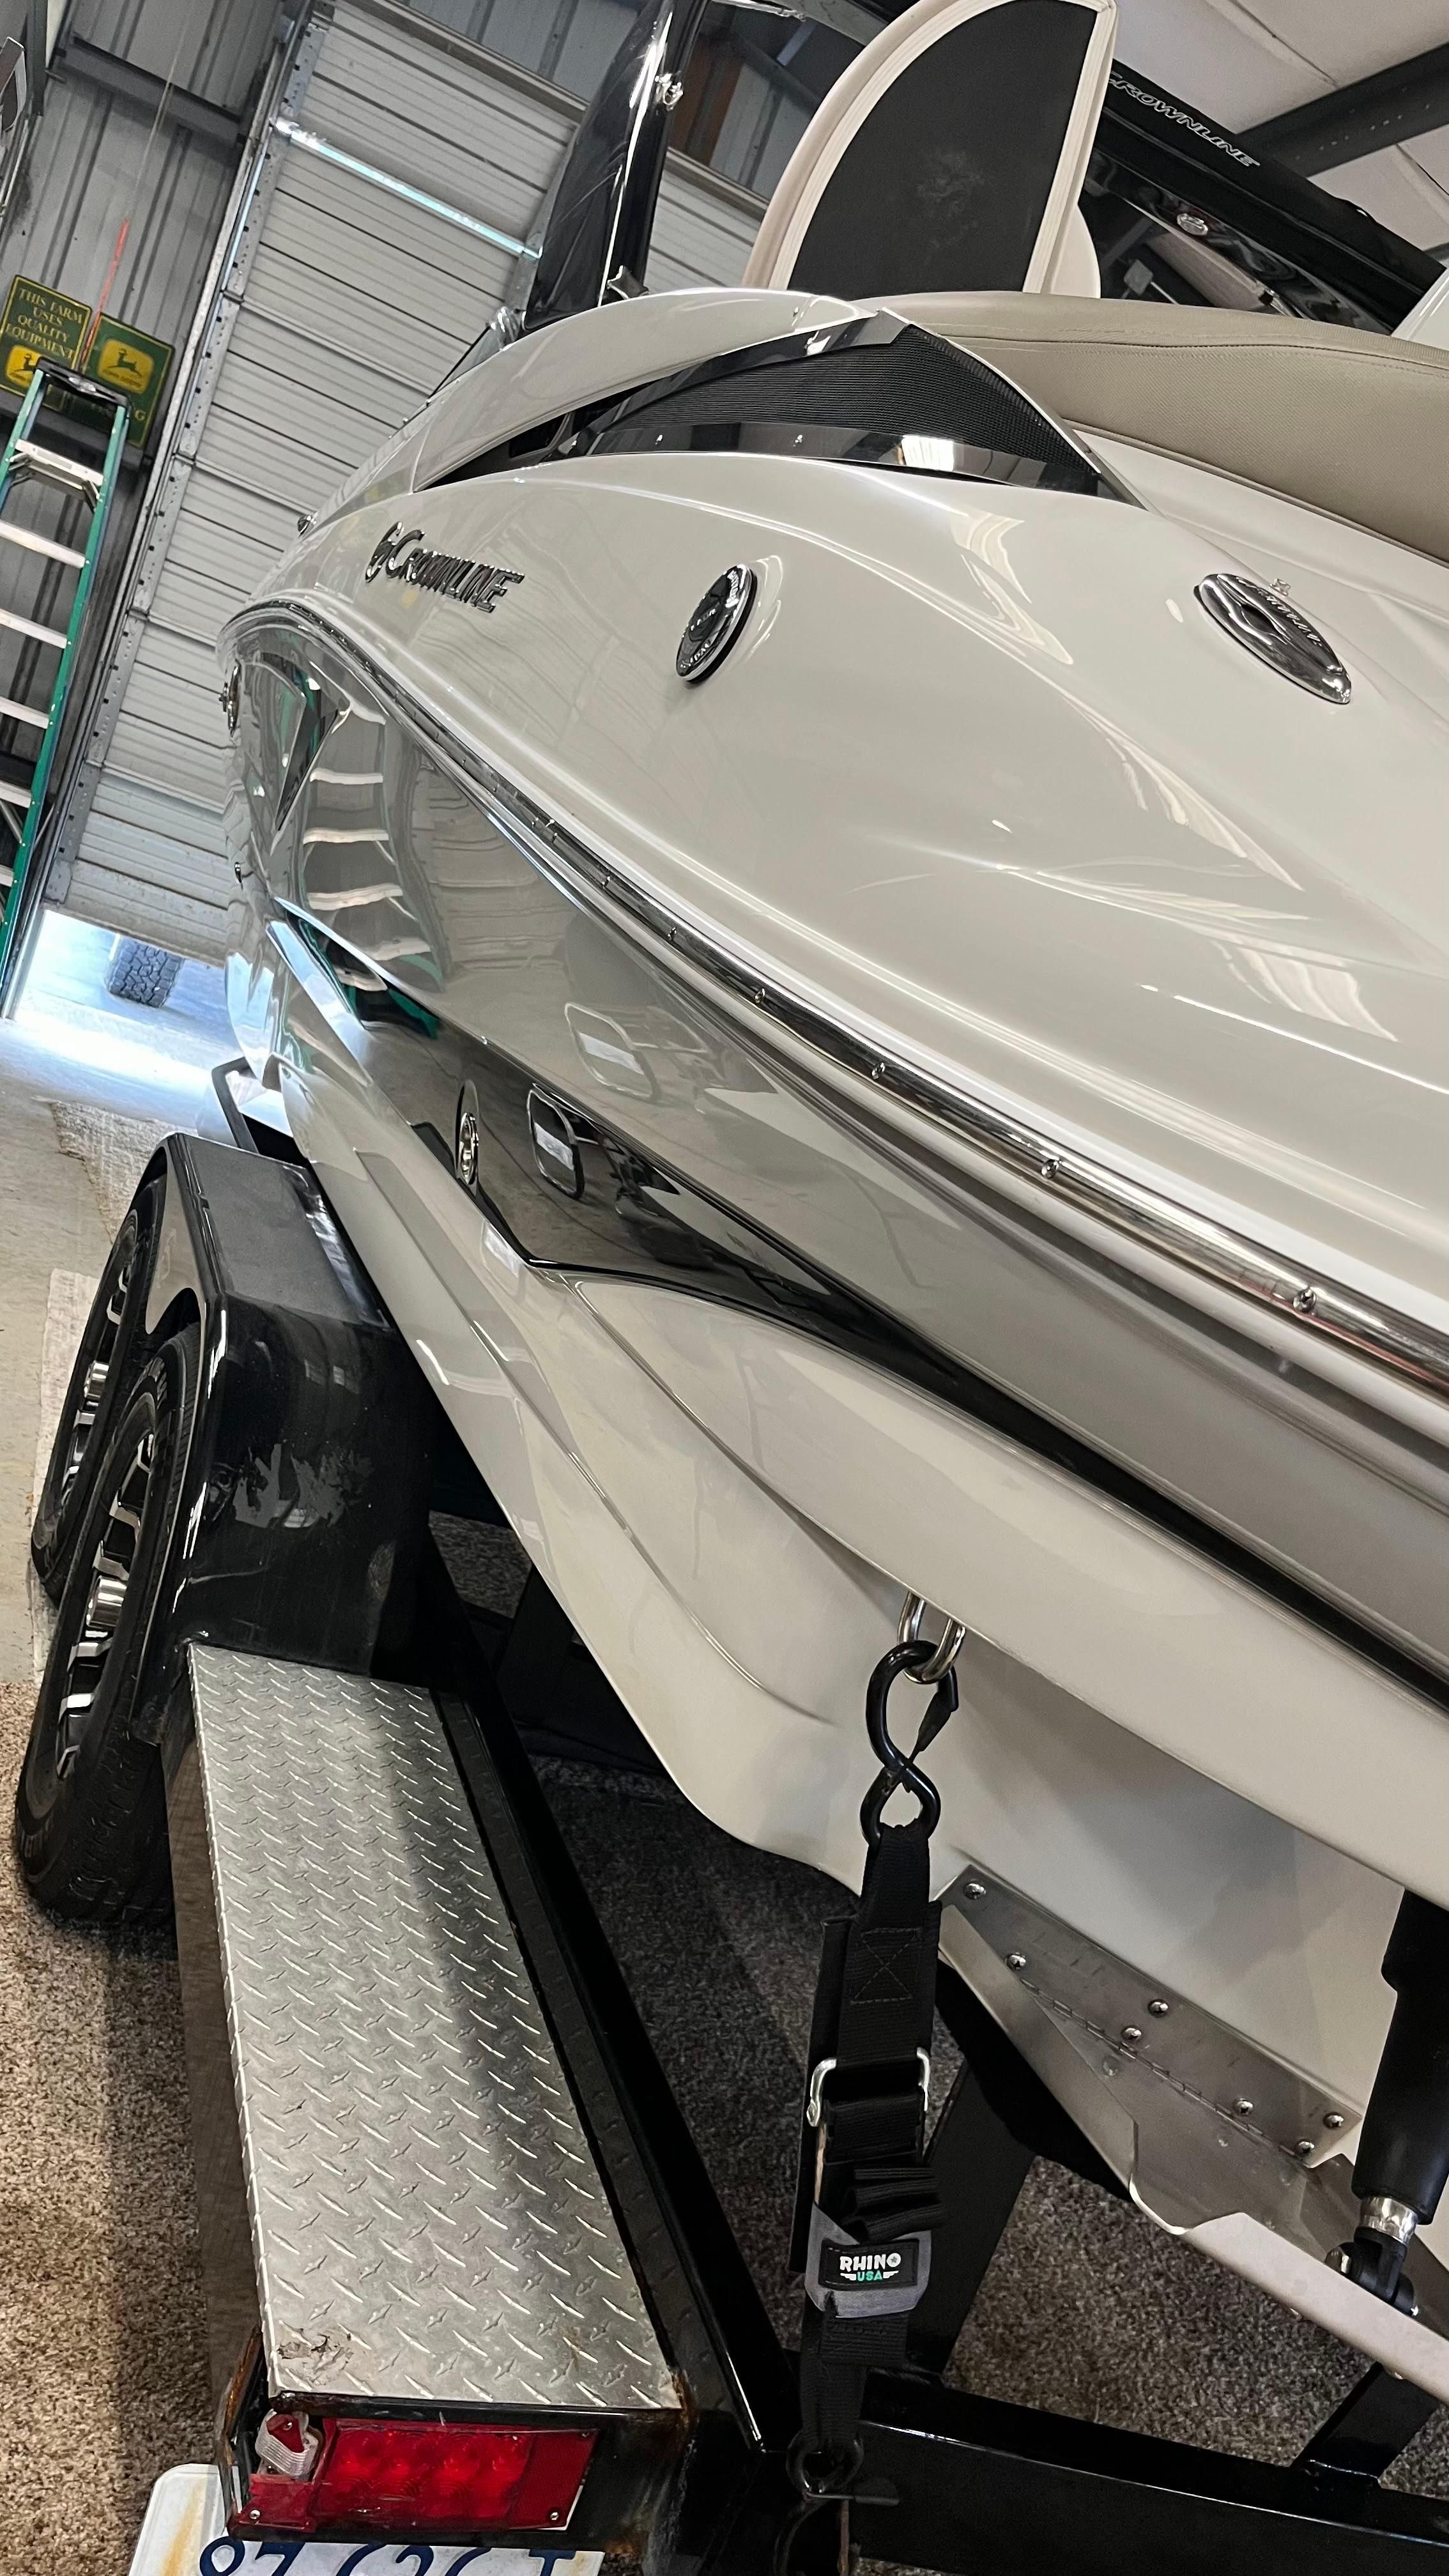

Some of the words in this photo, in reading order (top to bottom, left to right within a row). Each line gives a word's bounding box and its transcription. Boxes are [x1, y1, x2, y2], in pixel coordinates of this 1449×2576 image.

[20, 288, 47, 306] THIS
[50, 301, 83, 324] FARM
[33, 307, 63, 326] USES
[17, 314, 70, 343] QUALITY
[6, 323, 75, 359] EQUIPMENT
[839, 2253, 901, 2272] RHINO
[856, 2270, 882, 2281] USA
